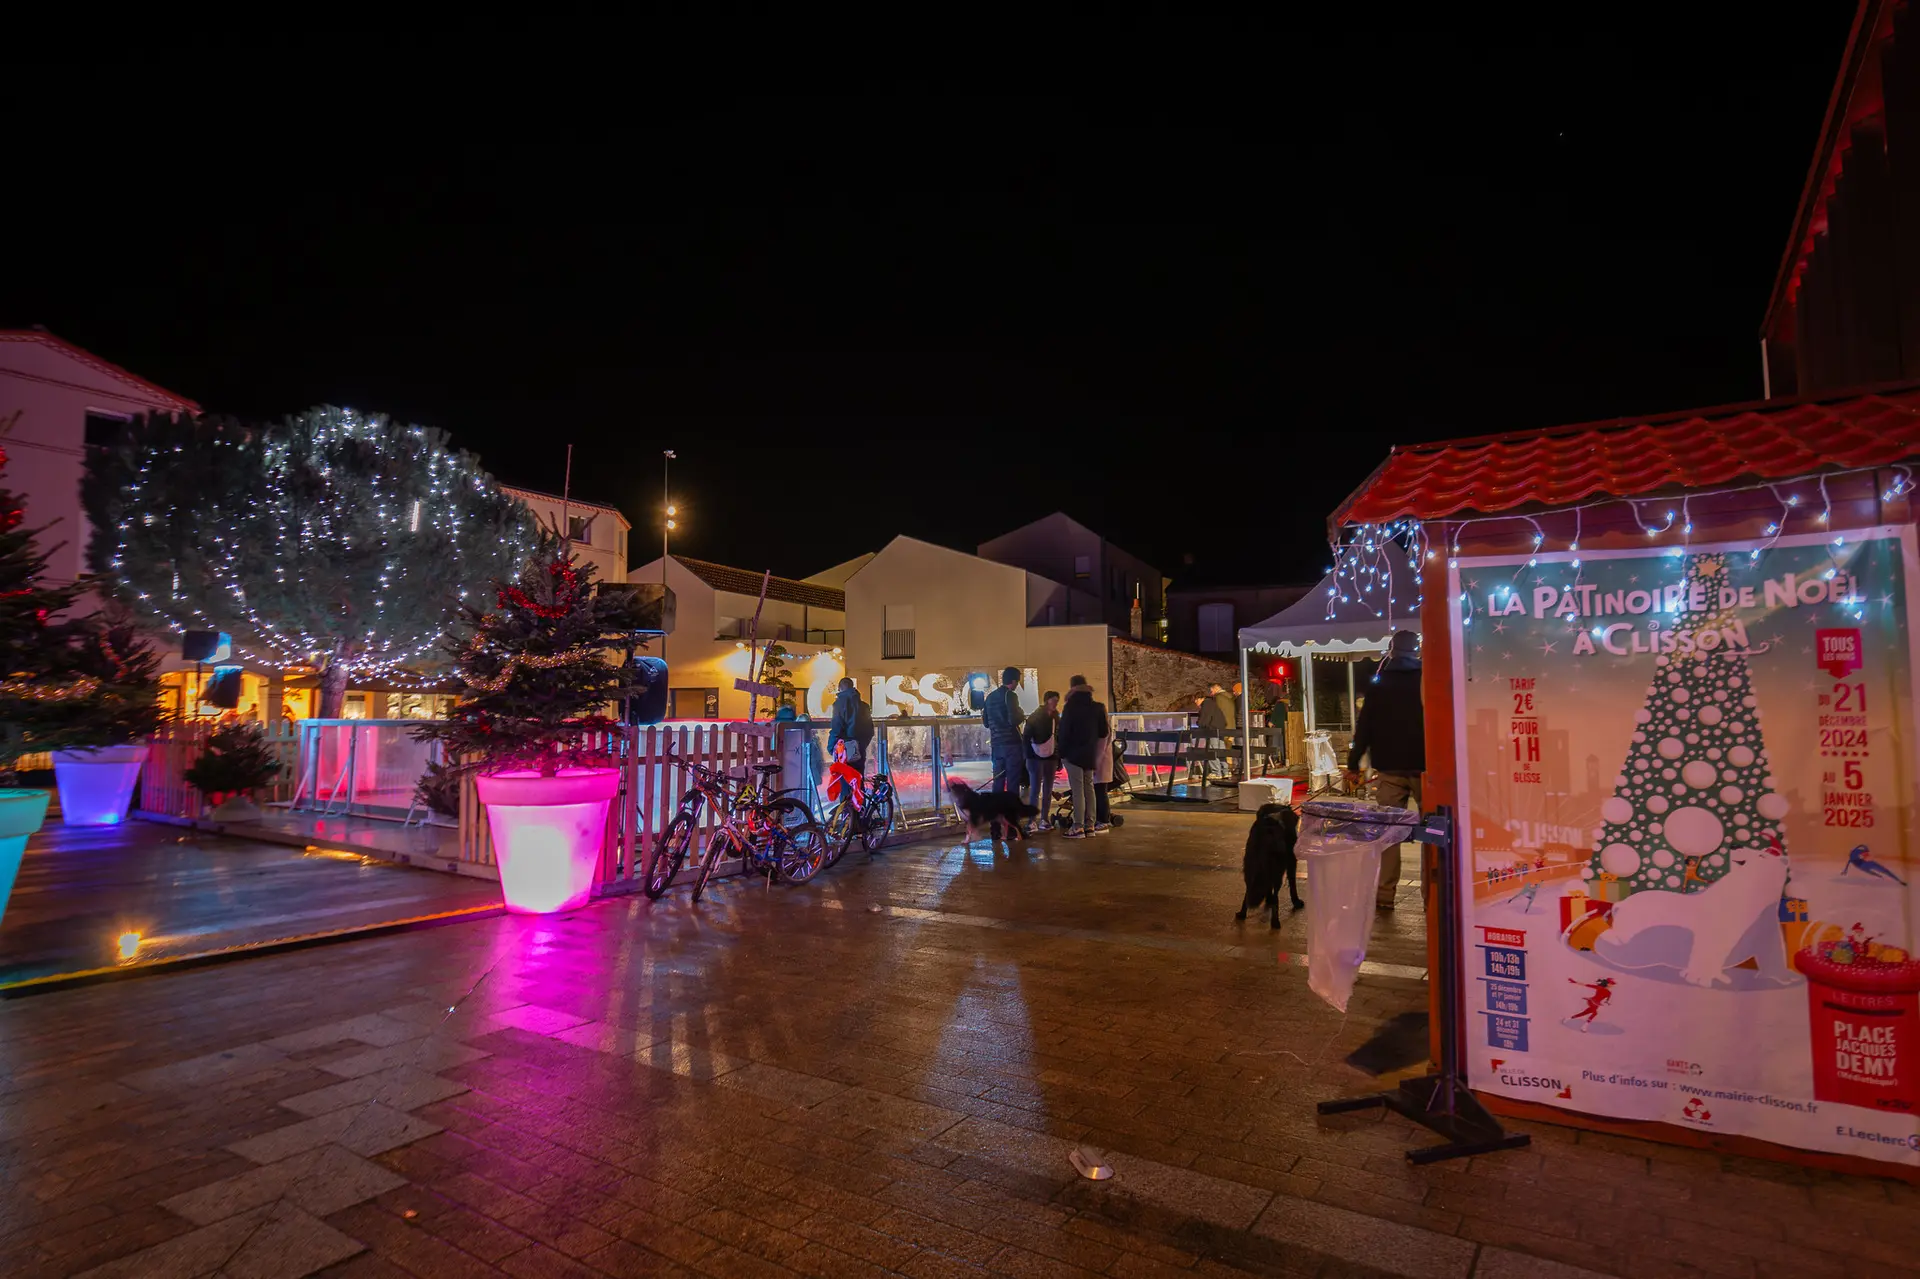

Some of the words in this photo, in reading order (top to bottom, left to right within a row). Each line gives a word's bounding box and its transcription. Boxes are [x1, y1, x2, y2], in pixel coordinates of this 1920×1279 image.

[1488, 592, 1527, 617] LA
[1533, 584, 1708, 620] PATINOIRE
[1719, 586, 1756, 610] DE
[1822, 636, 1856, 652] TOUS
[1509, 677, 1536, 690] TARIF
[1514, 693, 1533, 714] 2€
[1818, 694, 1831, 706] DU
[1833, 682, 1866, 712] 21
[1511, 721, 1538, 735] POUR
[1819, 729, 1868, 748] 2024
[1512, 736, 1521, 761] 1
[1527, 736, 1540, 762] H
[1513, 772, 1542, 784] GLISSE
[1823, 772, 1836, 783] AU
[1844, 760, 1863, 790] 5
[1823, 792, 1873, 807] JANVIER
[1824, 808, 1874, 829] 2025
[1487, 931, 1522, 944] HORAIRES
[1832, 990, 1895, 1007] LETTRES
[1834, 1020, 1896, 1045] PLACE
[1836, 1038, 1897, 1058] JACQUES
[1836, 1050, 1897, 1077] DEMY
[1501, 1075, 1562, 1090] CLISSON
[1582, 1070, 1607, 1084] Plus
[1609, 1074, 1649, 1089] d'infos
[1651, 1080, 1669, 1089] sur
[1679, 1083, 1818, 1115] www.mairie-clisson.fr
[1836, 1126, 1908, 1148] E.Leclerc
